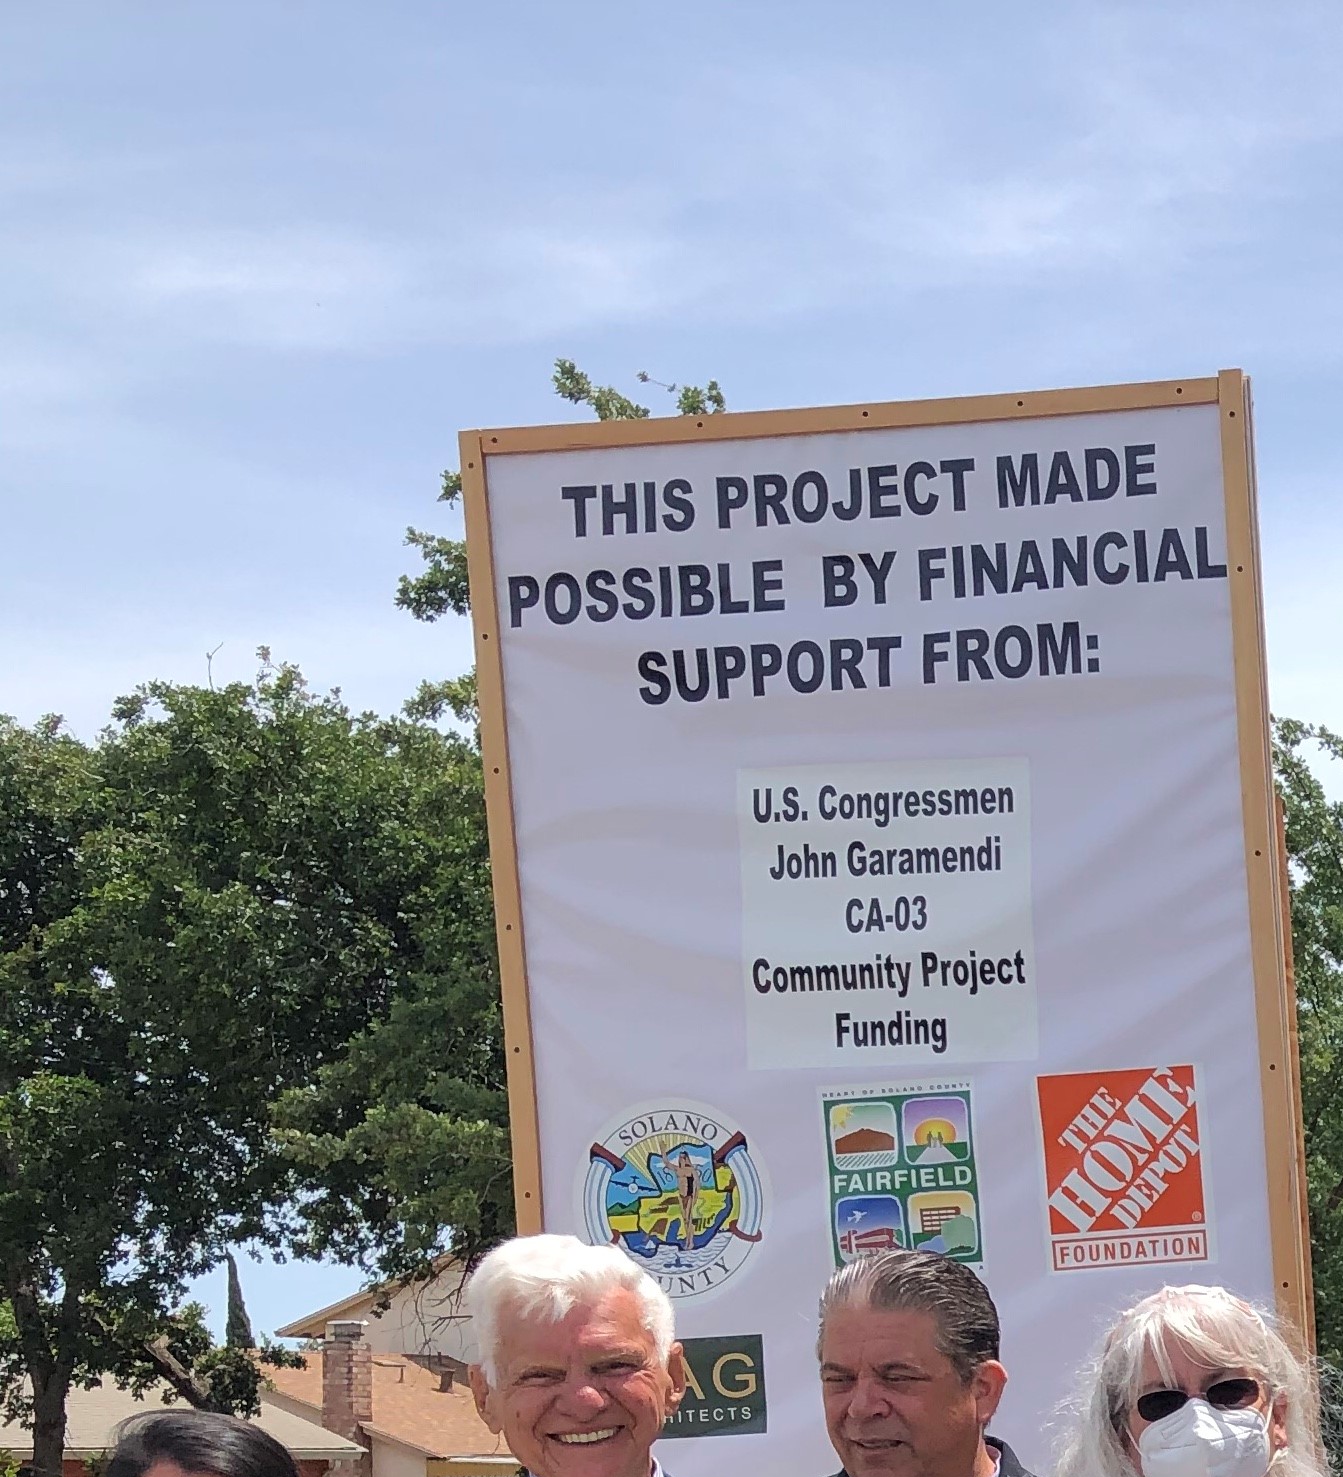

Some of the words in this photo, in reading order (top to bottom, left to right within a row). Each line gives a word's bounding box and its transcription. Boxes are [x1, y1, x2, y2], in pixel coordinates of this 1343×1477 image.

[561, 478, 695, 538] THIS
[717, 457, 975, 530] PROJECT
[997, 443, 1158, 509] MADE
[507, 560, 786, 629] POSSIBLE
[823, 551, 897, 608] BY
[918, 526, 1228, 603] FINANCIAL
[637, 636, 902, 706] SUPPORT
[922, 621, 1102, 685] FROM:
[752, 788, 809, 824] U.S.
[818, 781, 1015, 828] Congressmen
[769, 842, 838, 881] John
[846, 836, 1002, 877] Garamendi
[844, 897, 928, 934] CA-03
[751, 957, 911, 1000] Community
[921, 948, 1026, 994] Project
[835, 1012, 948, 1053] Funding
[618, 1113, 718, 1148] SOLANO
[1057, 1086, 1123, 1154] THE
[1048, 1065, 1201, 1233] HOME
[833, 1165, 973, 1194] FAIRFIELD
[1109, 1123, 1200, 1230] DEPOT
[1059, 1236, 1201, 1265] FOUNDATION
[657, 1256, 732, 1294] UNTY
